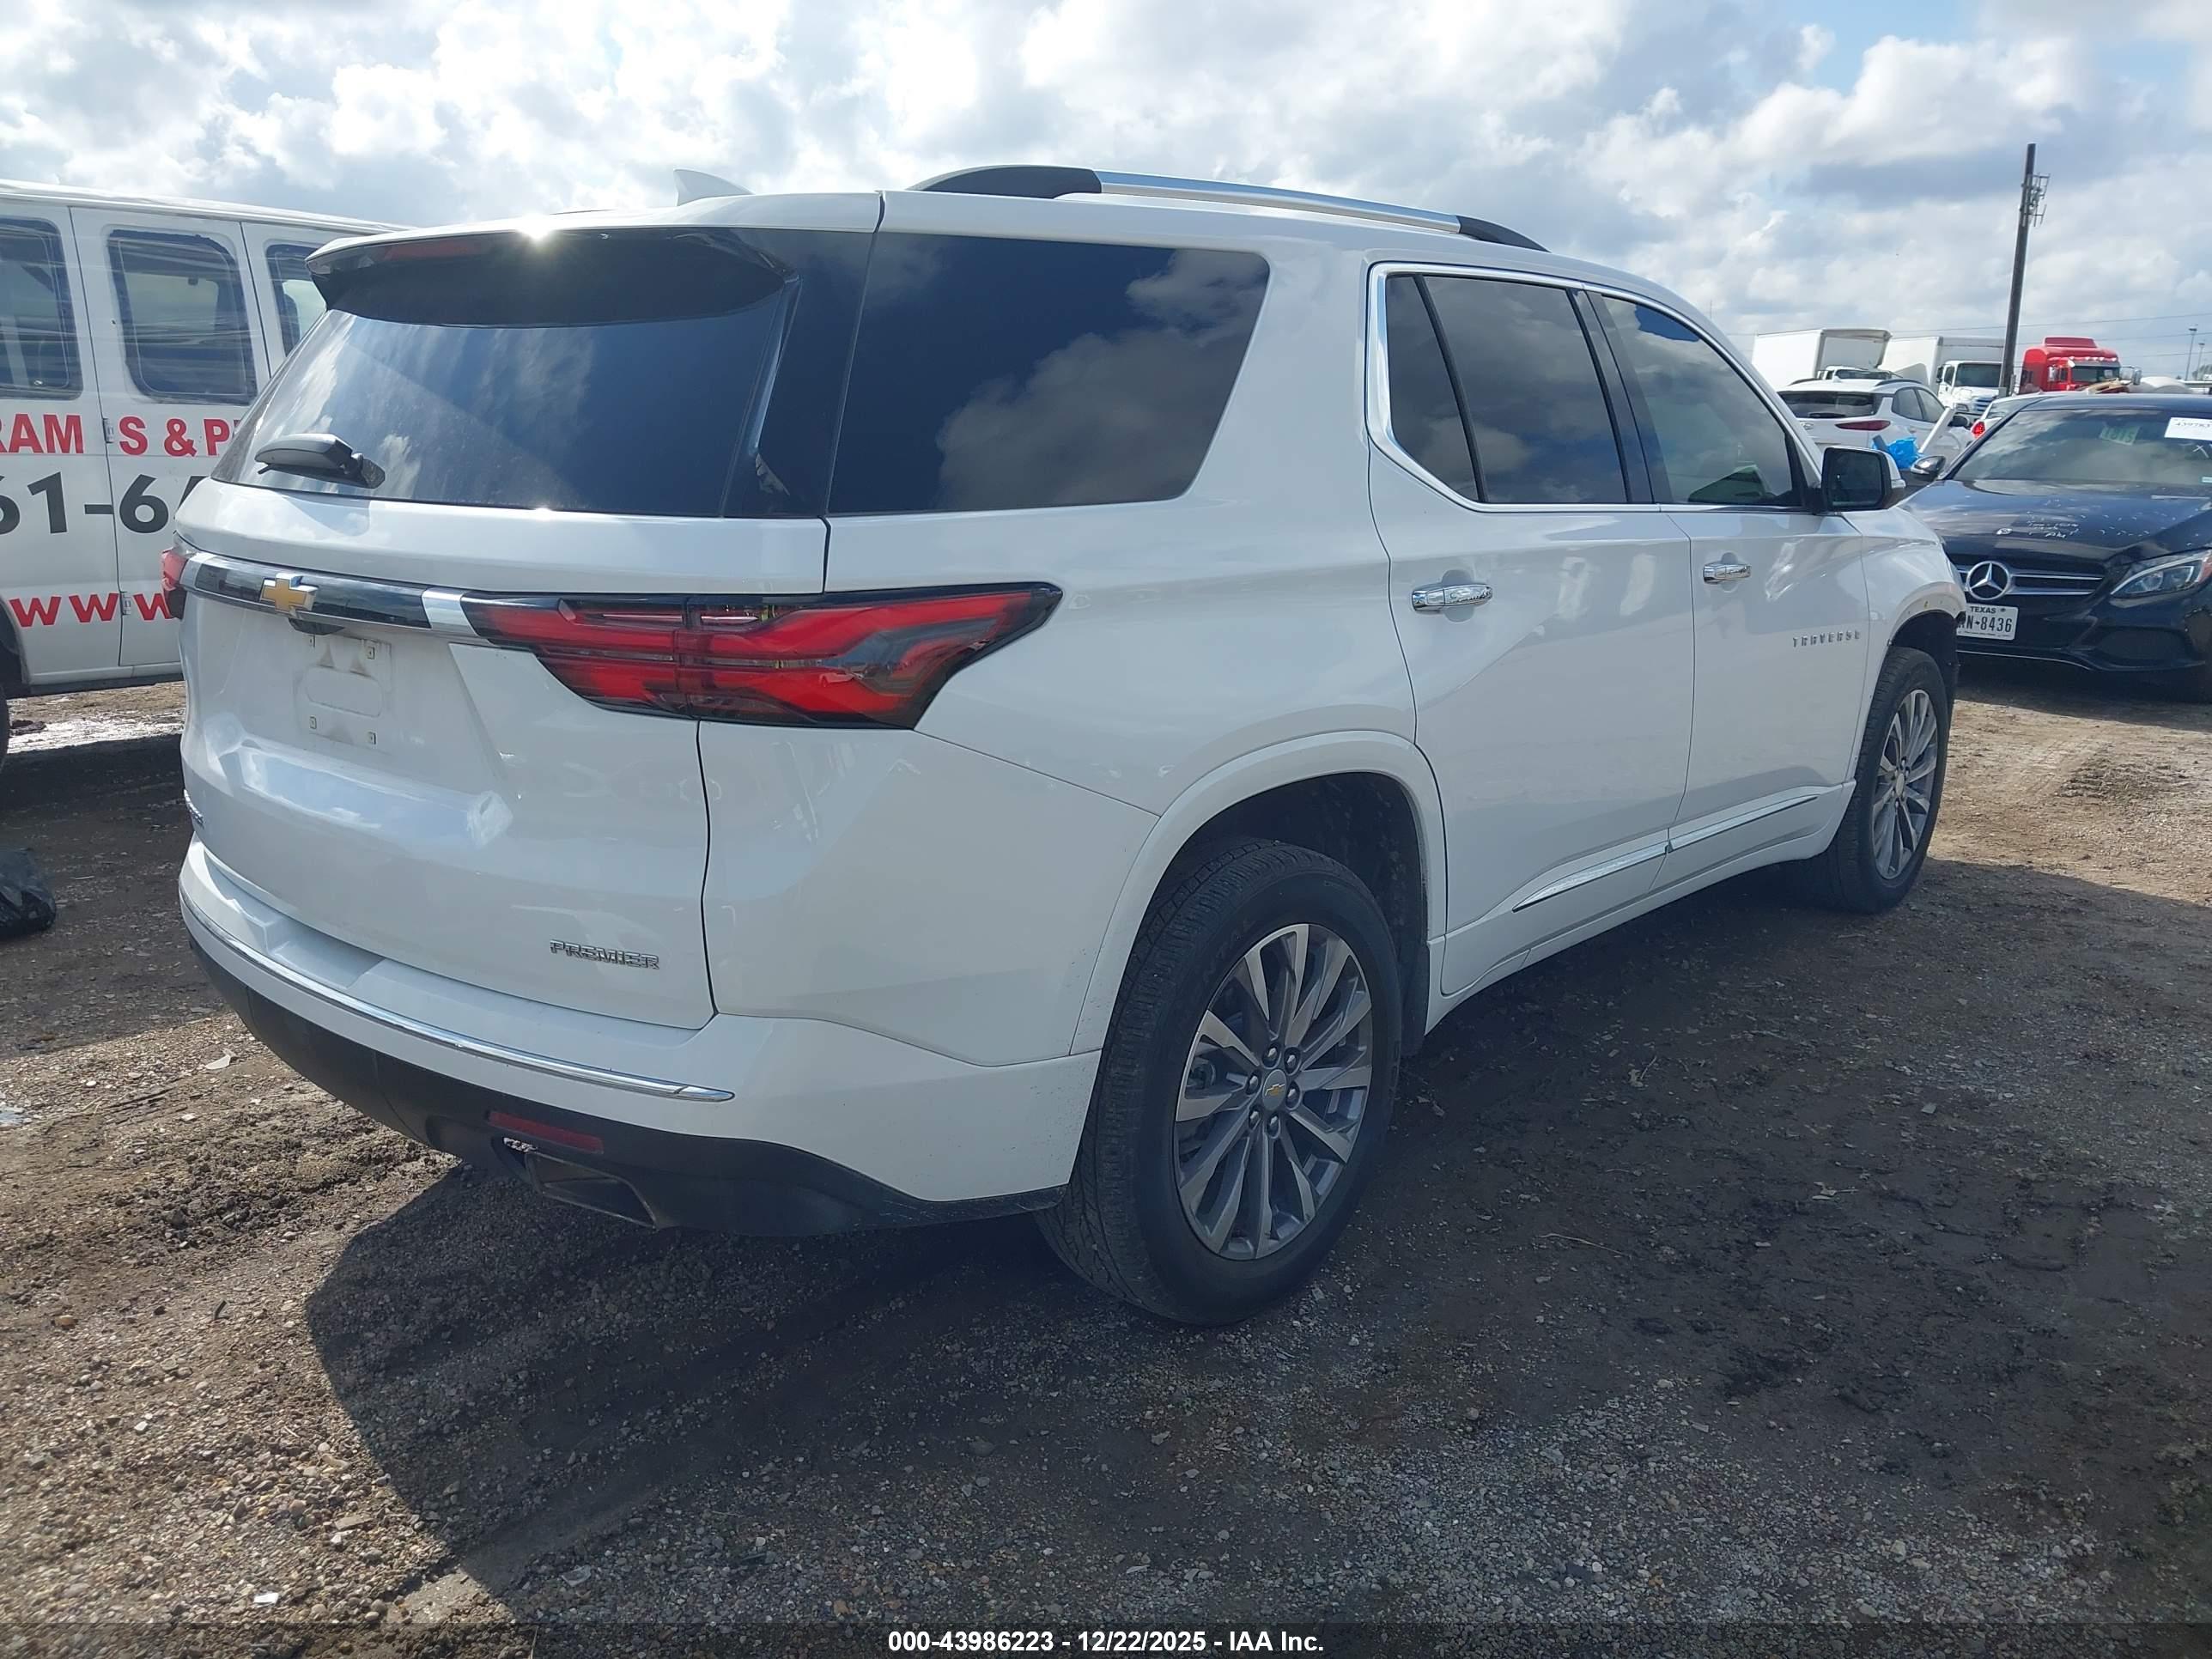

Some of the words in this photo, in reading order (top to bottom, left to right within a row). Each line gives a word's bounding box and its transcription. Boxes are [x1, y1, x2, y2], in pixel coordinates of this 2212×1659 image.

[0, 414, 83, 454] AM
[118, 416, 149, 456] S
[163, 418, 197, 457] &
[204, 419, 241, 456] P
[550, 939, 659, 970] PREMIER
